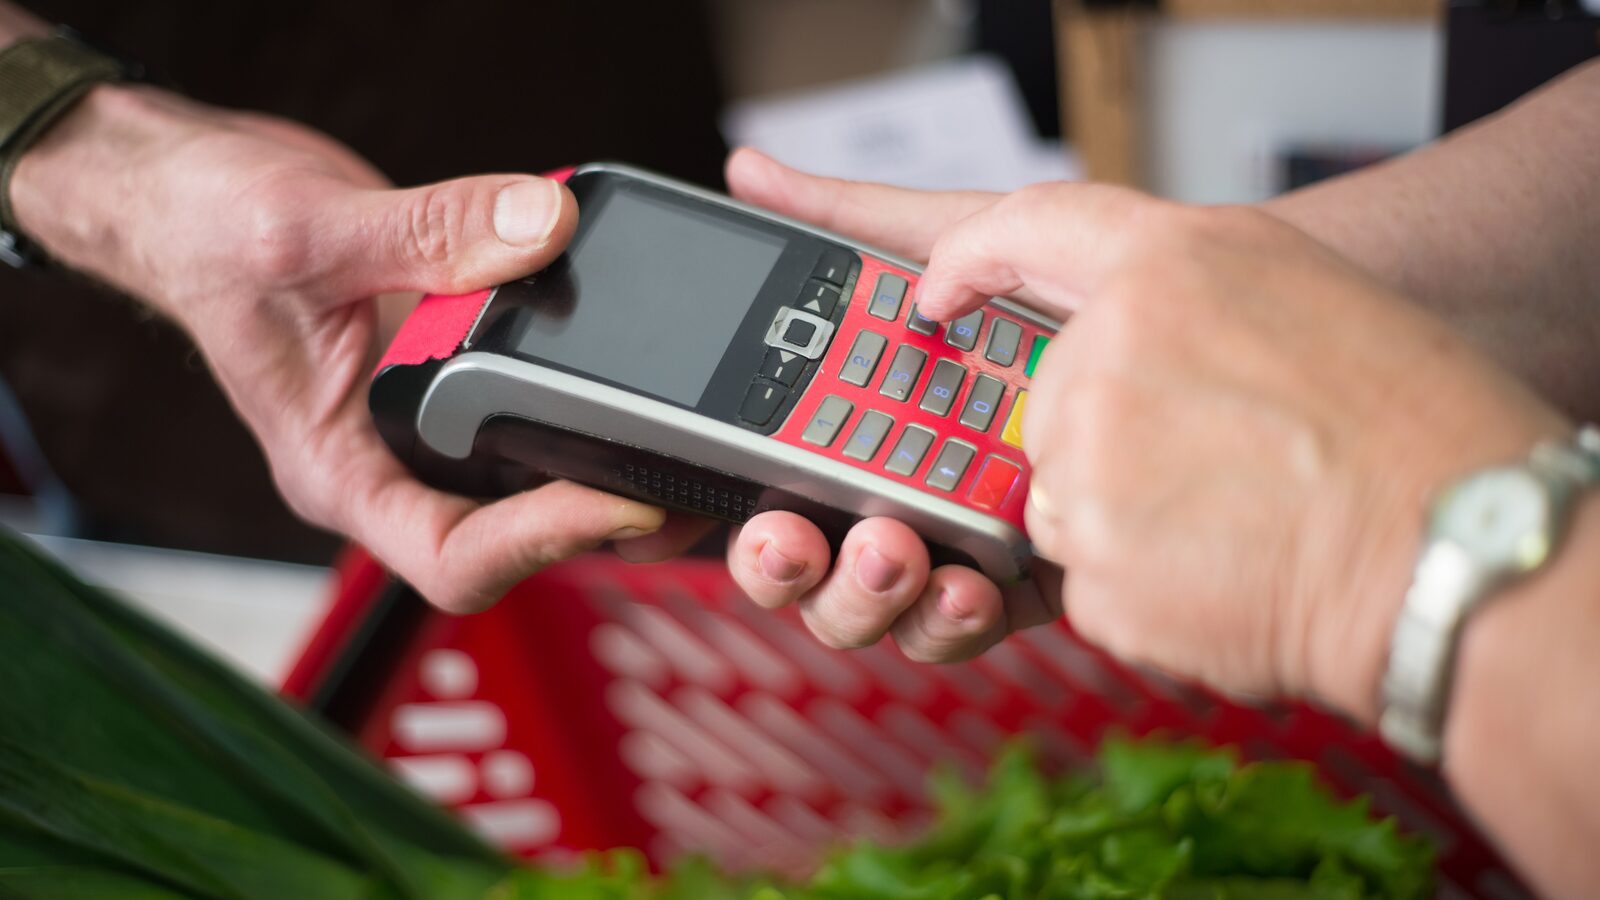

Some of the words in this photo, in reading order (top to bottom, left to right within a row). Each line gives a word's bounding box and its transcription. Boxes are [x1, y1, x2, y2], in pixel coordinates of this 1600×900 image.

[878, 294, 897, 305] 3
[955, 326, 973, 338] 9
[853, 355, 871, 369] 2
[892, 369, 910, 382] 5
[933, 386, 949, 399] 8
[973, 400, 990, 413] 0
[817, 419, 834, 427] 1
[898, 450, 915, 463] 7
